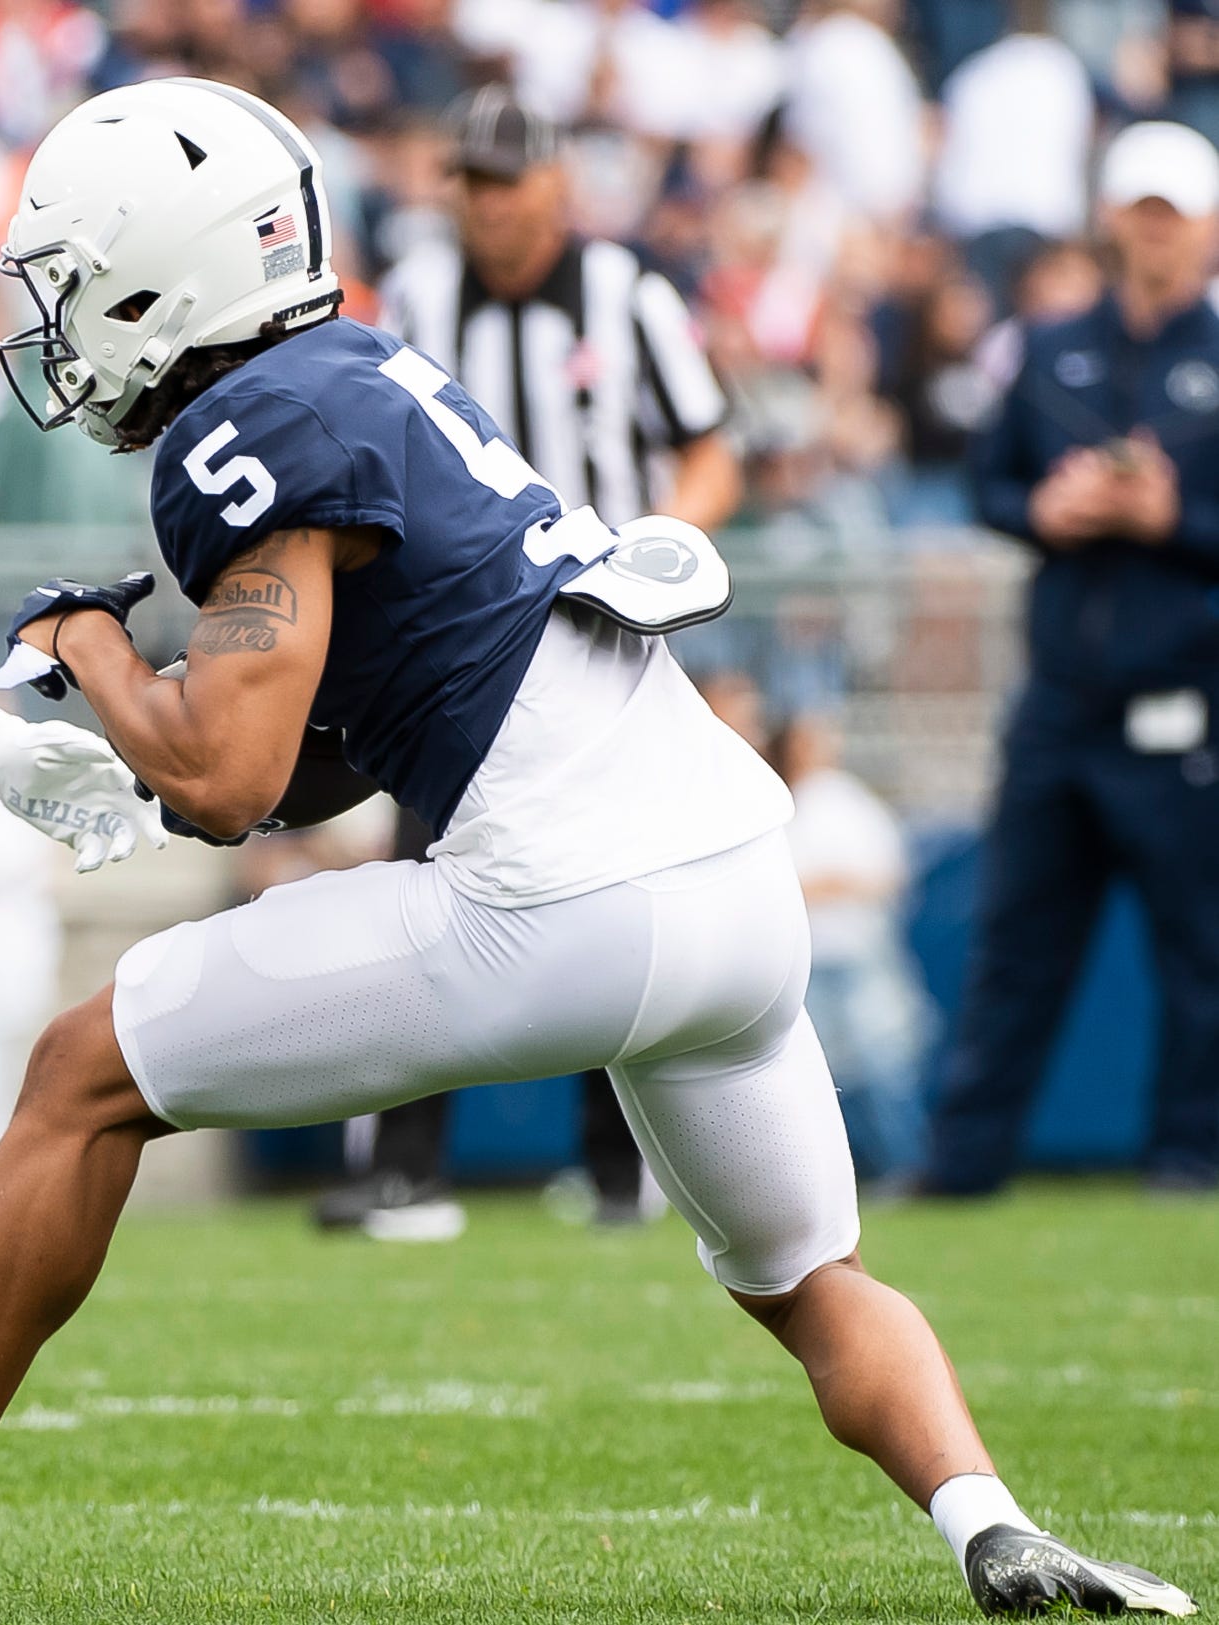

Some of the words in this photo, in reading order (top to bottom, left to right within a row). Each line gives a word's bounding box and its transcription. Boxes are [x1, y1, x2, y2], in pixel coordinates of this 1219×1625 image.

[182, 419, 277, 527] 5
[225, 582, 283, 606] shall
[9, 787, 91, 830] STATE
